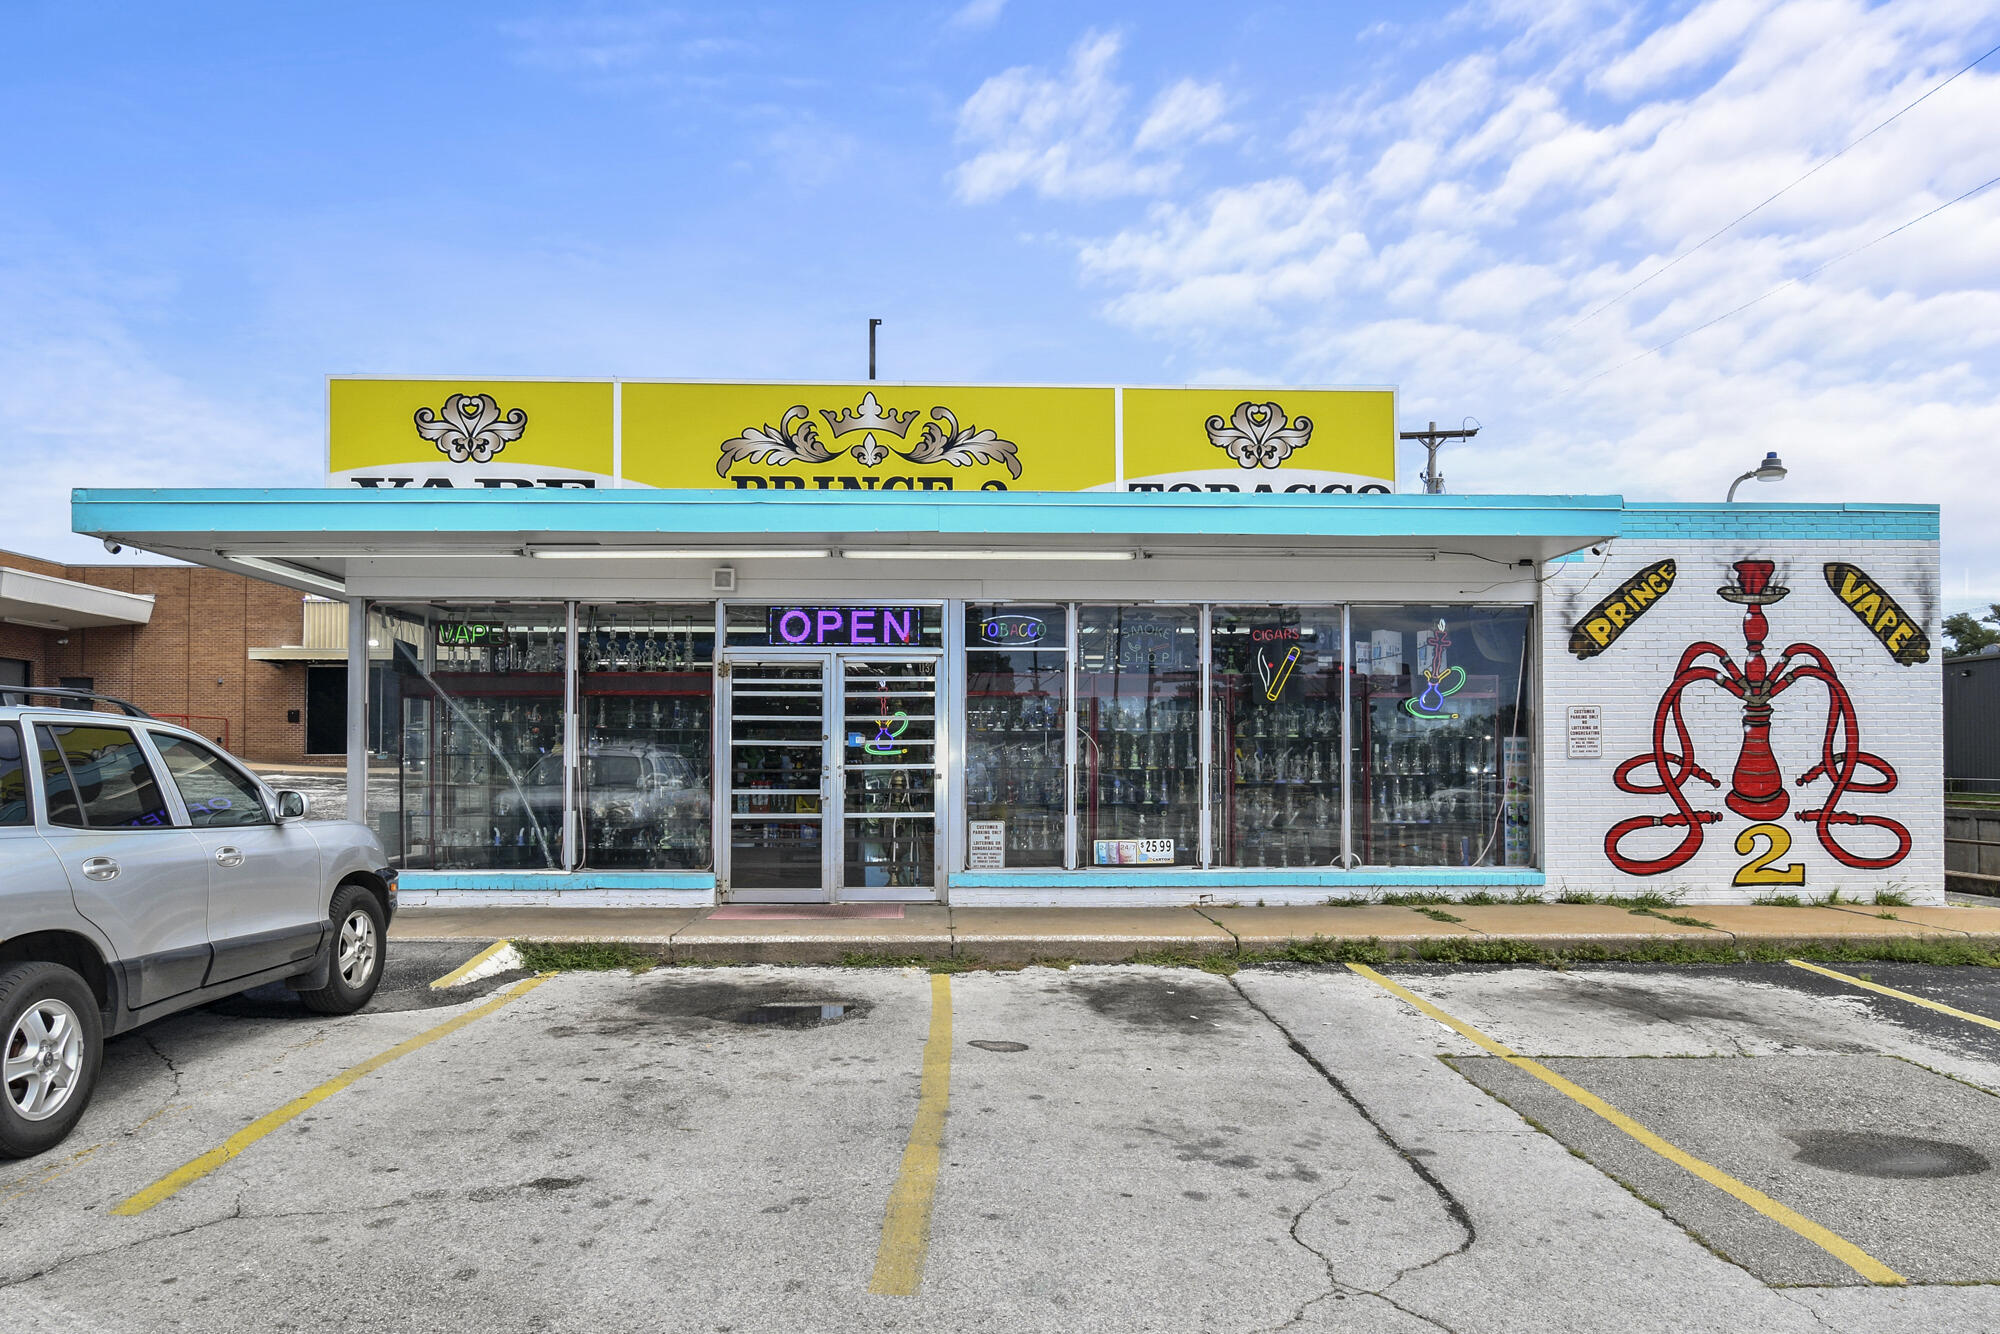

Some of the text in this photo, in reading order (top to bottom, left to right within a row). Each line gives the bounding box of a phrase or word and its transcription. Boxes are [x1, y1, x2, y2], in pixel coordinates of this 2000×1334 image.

[1585, 564, 1675, 647] PRINCE
[1840, 571, 1914, 653] VAPE
[440, 624, 504, 644] VAPE
[779, 610, 910, 643] OPEN
[979, 622, 1047, 638] TOBACCO
[1121, 624, 1170, 640] SMOKE
[1252, 628, 1300, 641] CIGARS
[1124, 651, 1170, 663] SHOP
[1731, 823, 1805, 887] 2
